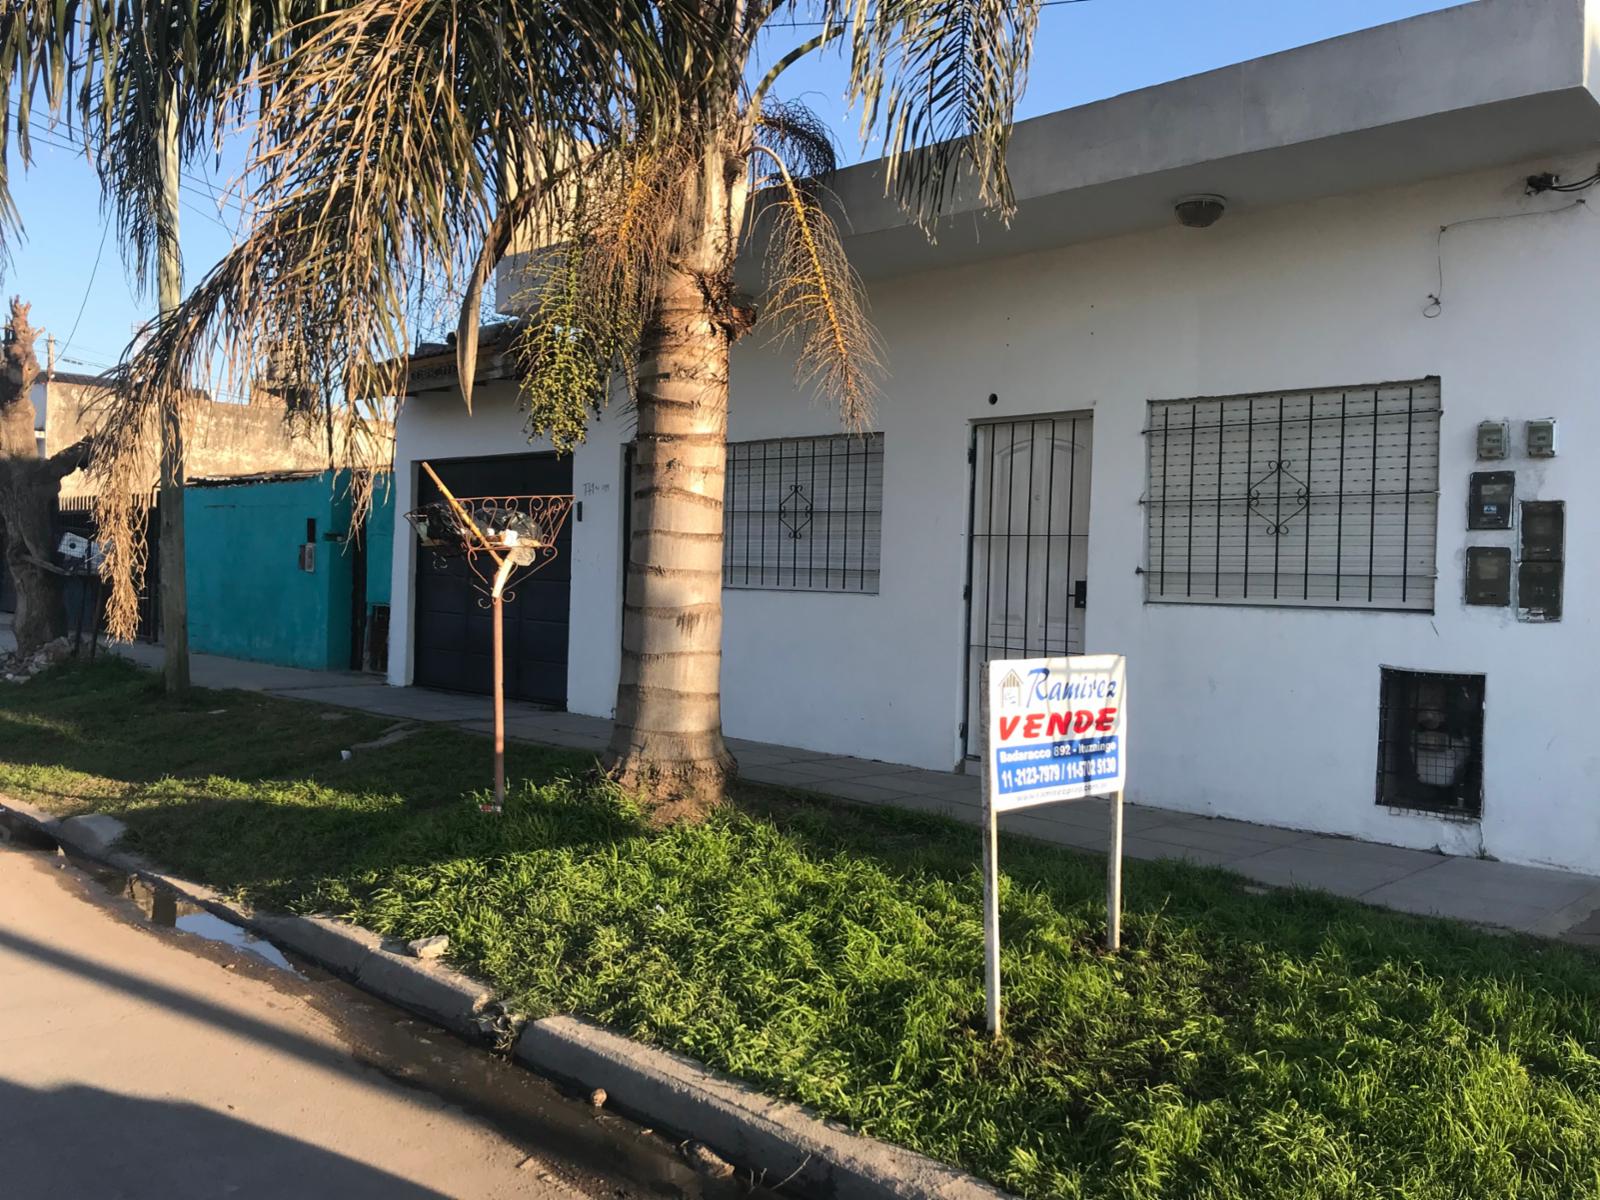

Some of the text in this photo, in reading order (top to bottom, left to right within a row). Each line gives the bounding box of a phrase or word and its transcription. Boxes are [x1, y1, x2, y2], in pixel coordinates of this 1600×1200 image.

[1026, 668, 1117, 708] Ramirez
[1000, 708, 1117, 740] VENDE
[1054, 744, 1071, 757] 892
[1001, 770, 1013, 788] 11
[1061, 763, 1066, 780] /
